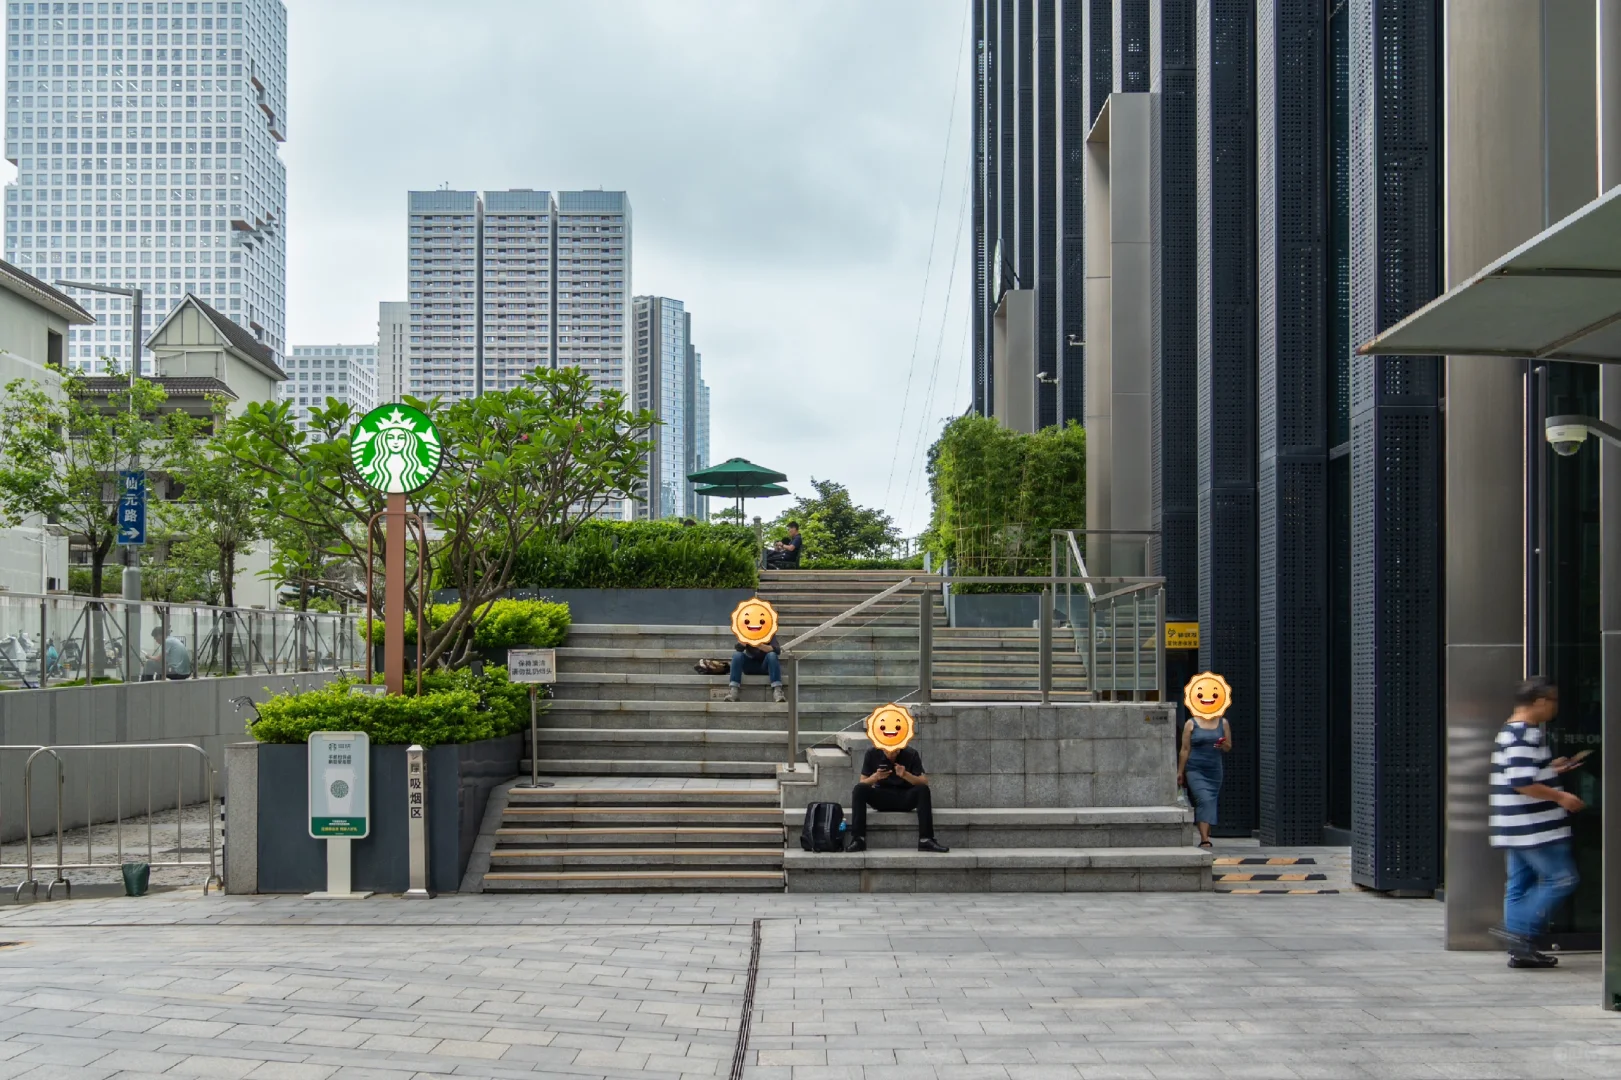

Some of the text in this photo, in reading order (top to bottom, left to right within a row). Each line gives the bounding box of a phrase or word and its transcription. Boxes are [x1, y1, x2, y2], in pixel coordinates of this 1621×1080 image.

[124, 476, 138, 522] 仙元路
[410, 778, 422, 818] 吸烟区
